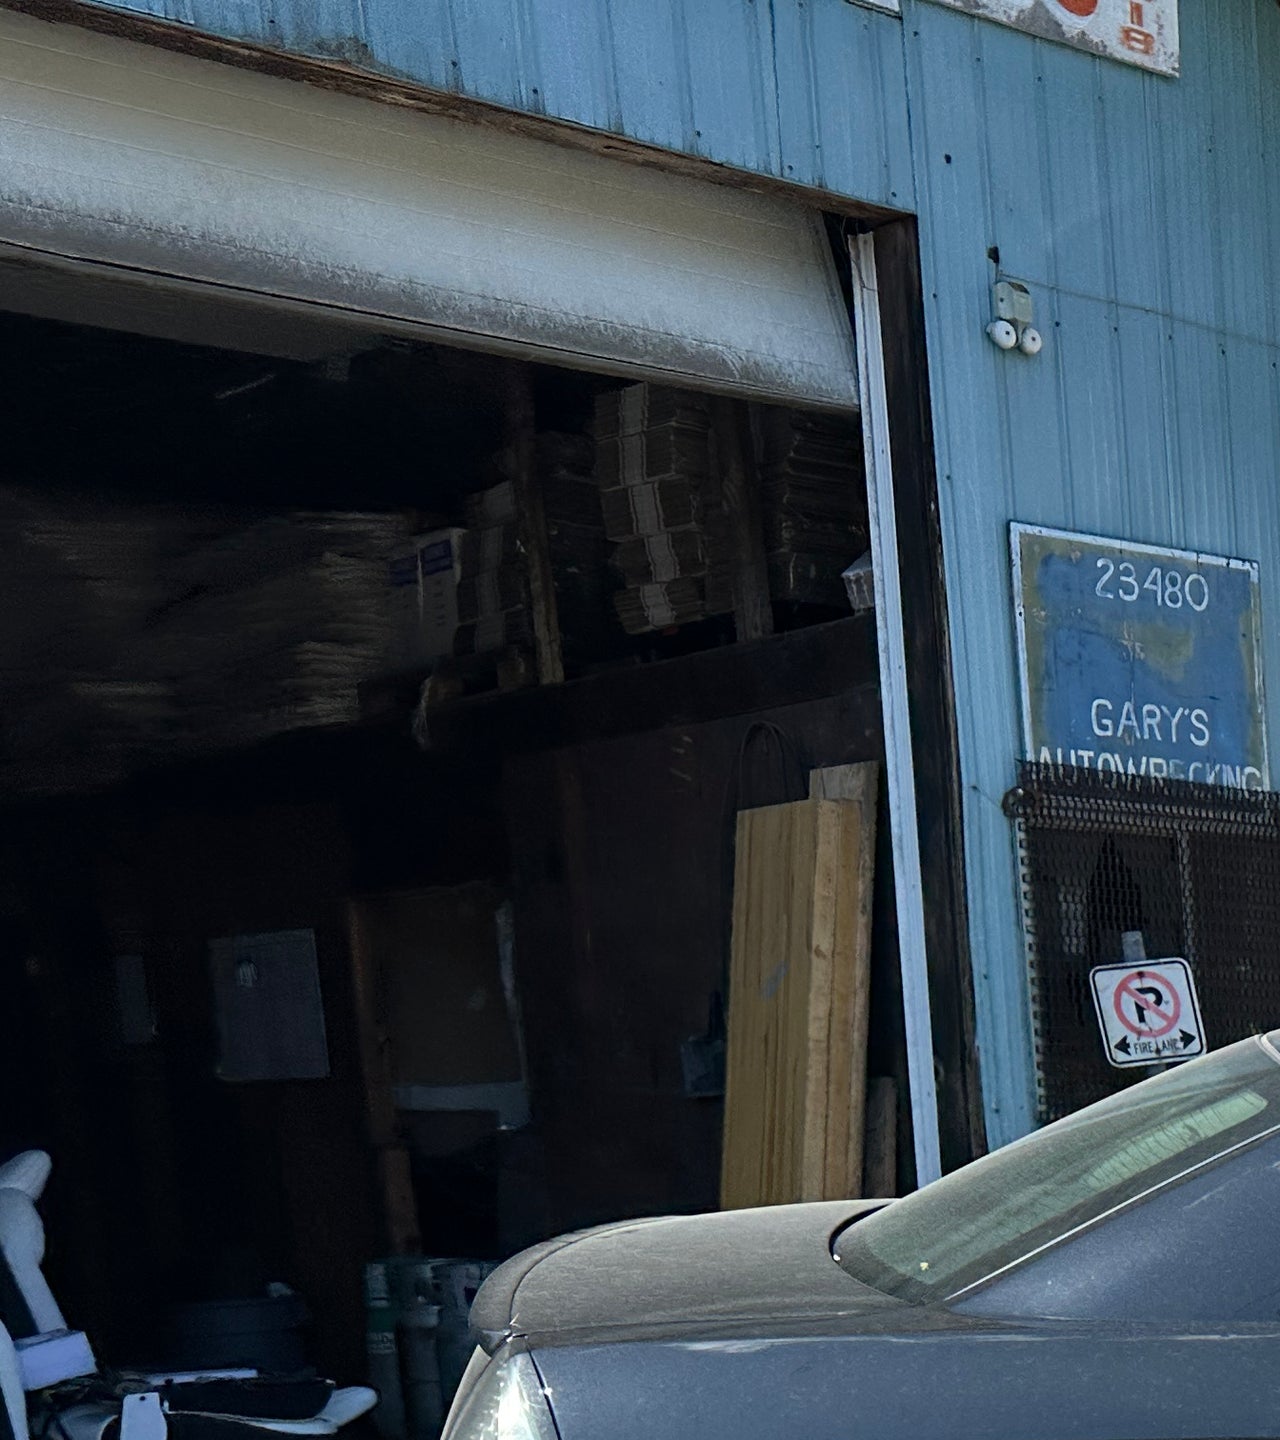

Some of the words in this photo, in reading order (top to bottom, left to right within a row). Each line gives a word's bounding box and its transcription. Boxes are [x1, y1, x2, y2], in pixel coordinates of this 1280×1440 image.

[1095, 558, 1209, 611] 23480
[1091, 699, 1210, 747] GARY'S
[1134, 1041, 1153, 1054] FIRE
